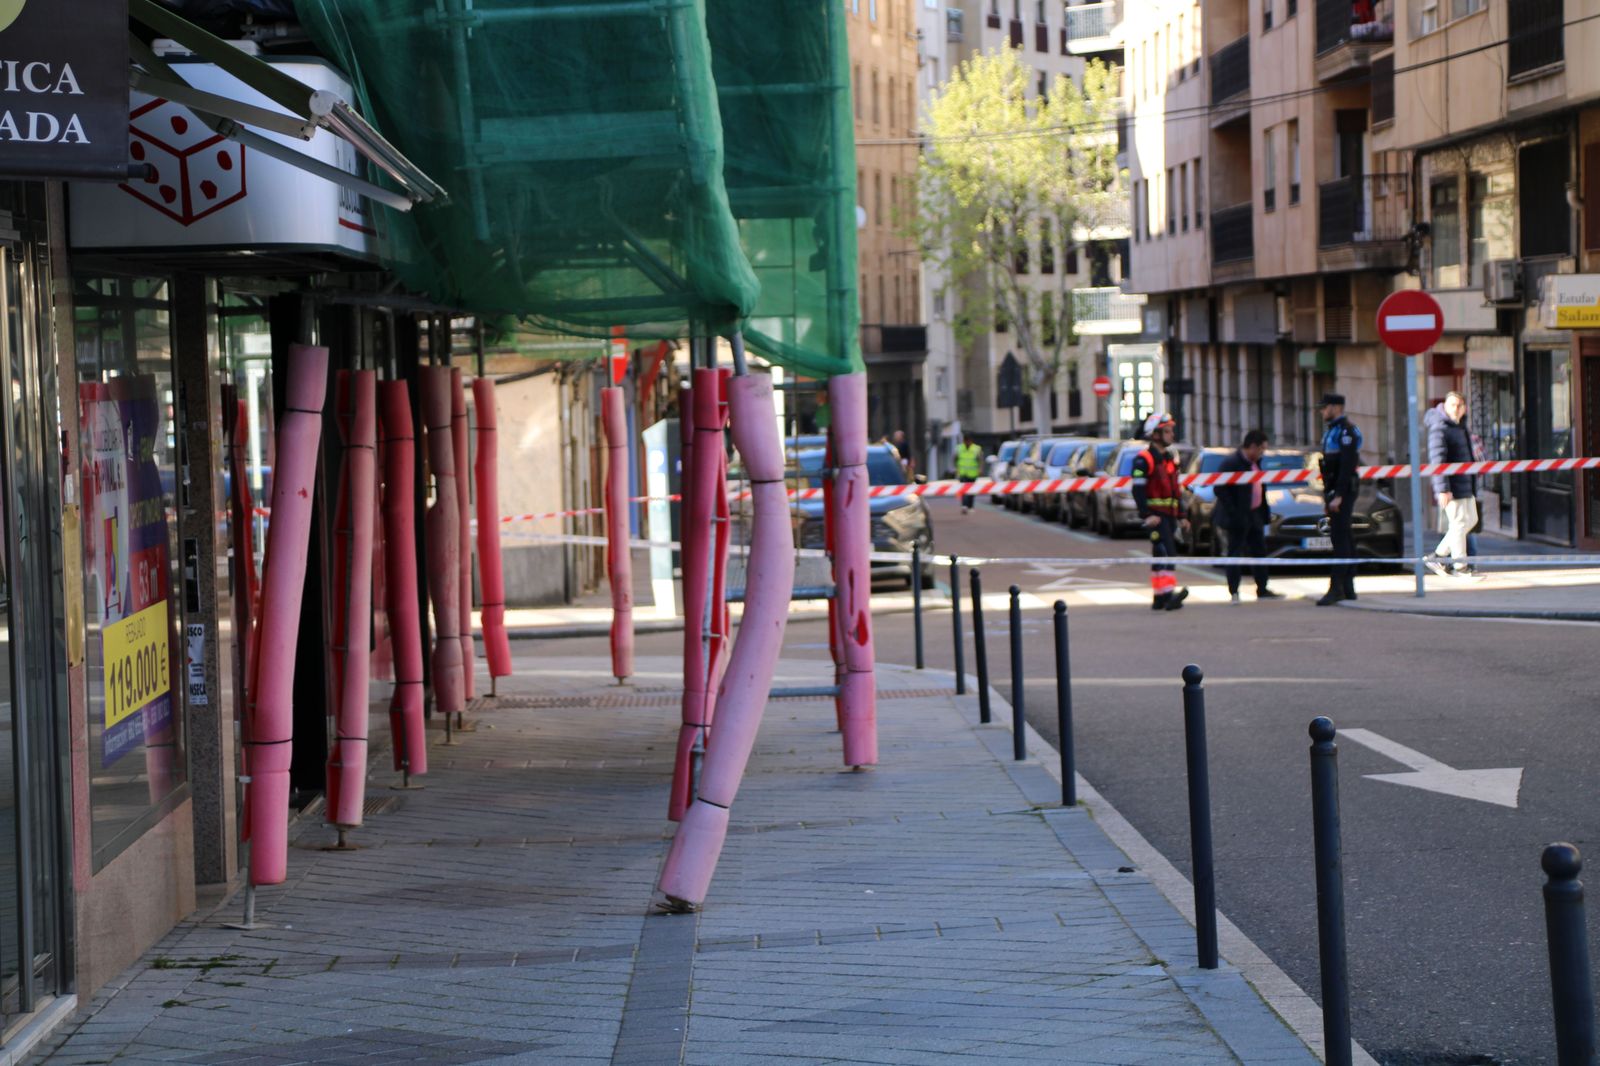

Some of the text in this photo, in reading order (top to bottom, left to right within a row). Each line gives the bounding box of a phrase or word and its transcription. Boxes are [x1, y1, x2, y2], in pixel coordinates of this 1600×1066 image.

[0, 60, 85, 95] ICA
[1559, 292, 1597, 304] Estufas
[110, 641, 167, 717] 119.000 €
